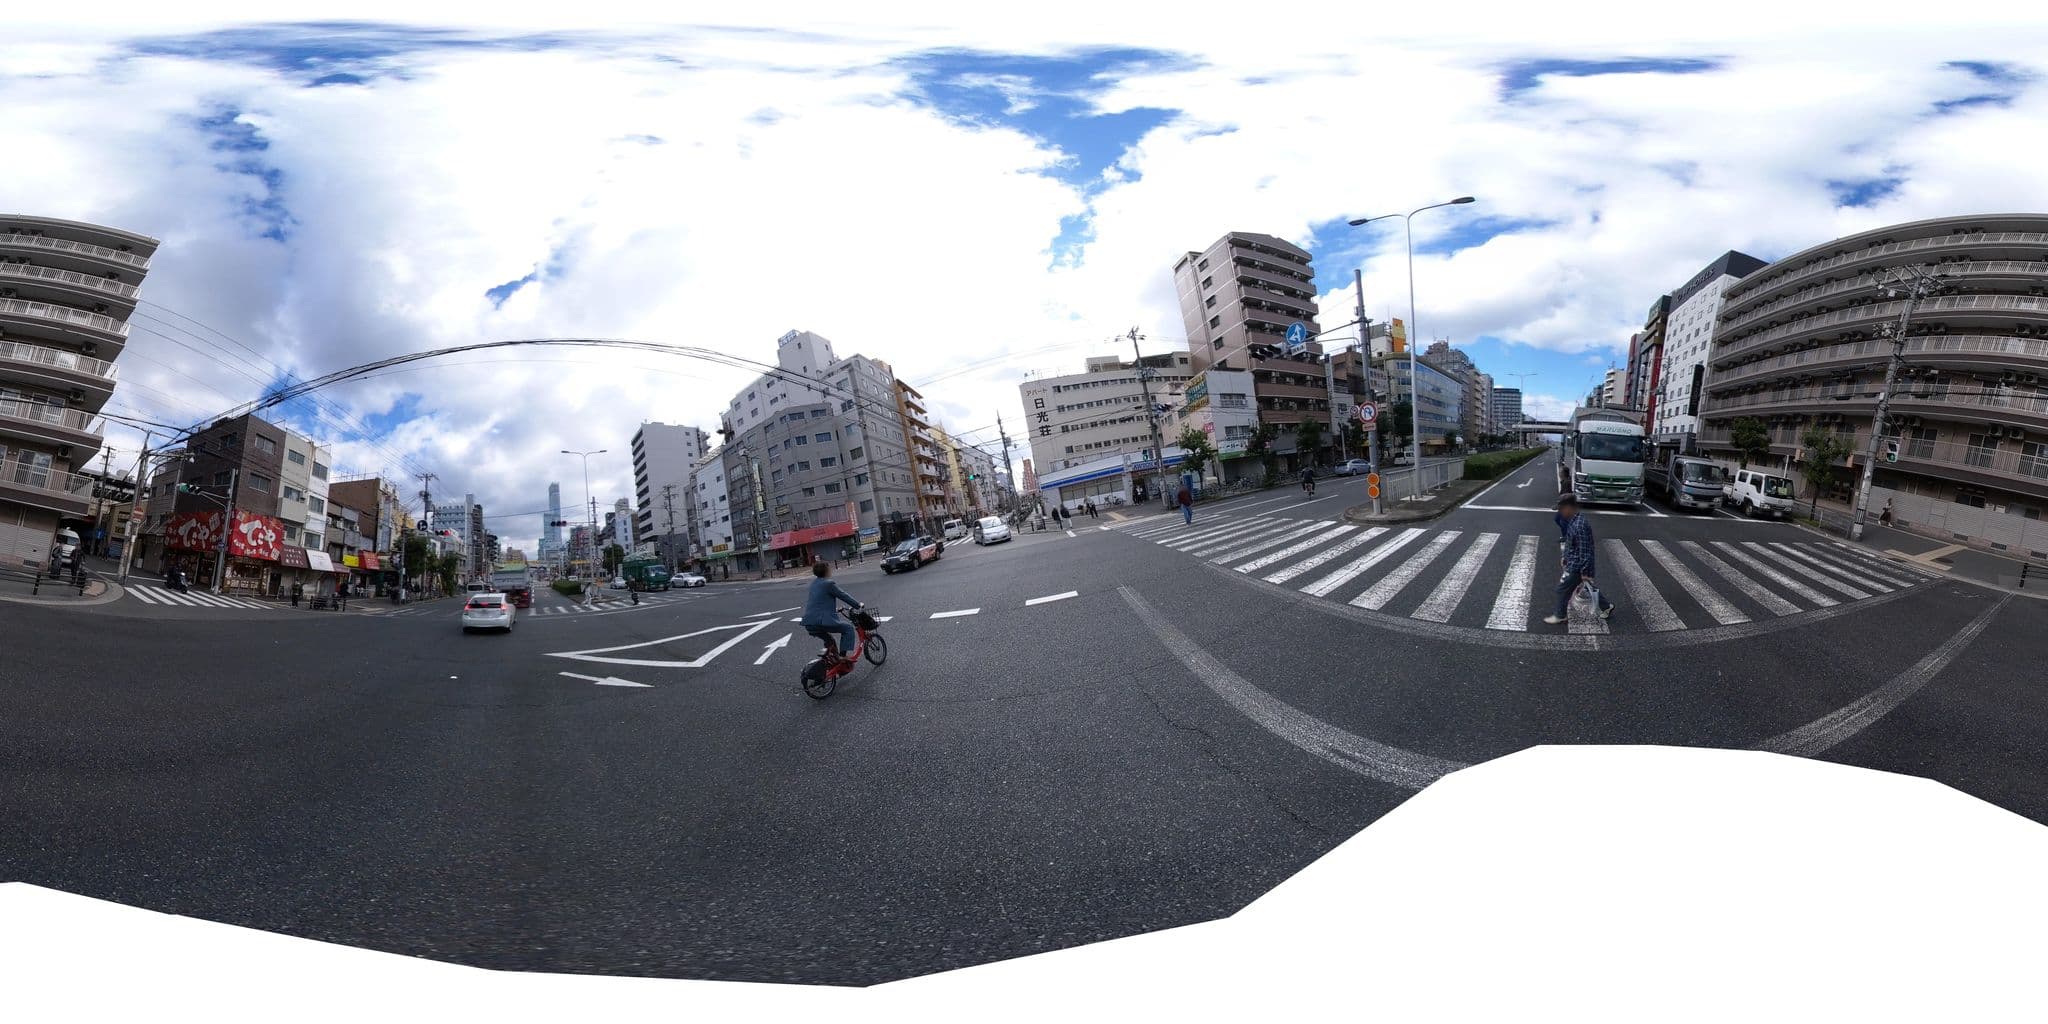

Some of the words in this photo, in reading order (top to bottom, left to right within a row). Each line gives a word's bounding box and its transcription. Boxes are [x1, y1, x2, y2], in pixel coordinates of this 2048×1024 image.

[1025, 388, 1048, 396] アパート
[1034, 398, 1051, 437] 日光荘
